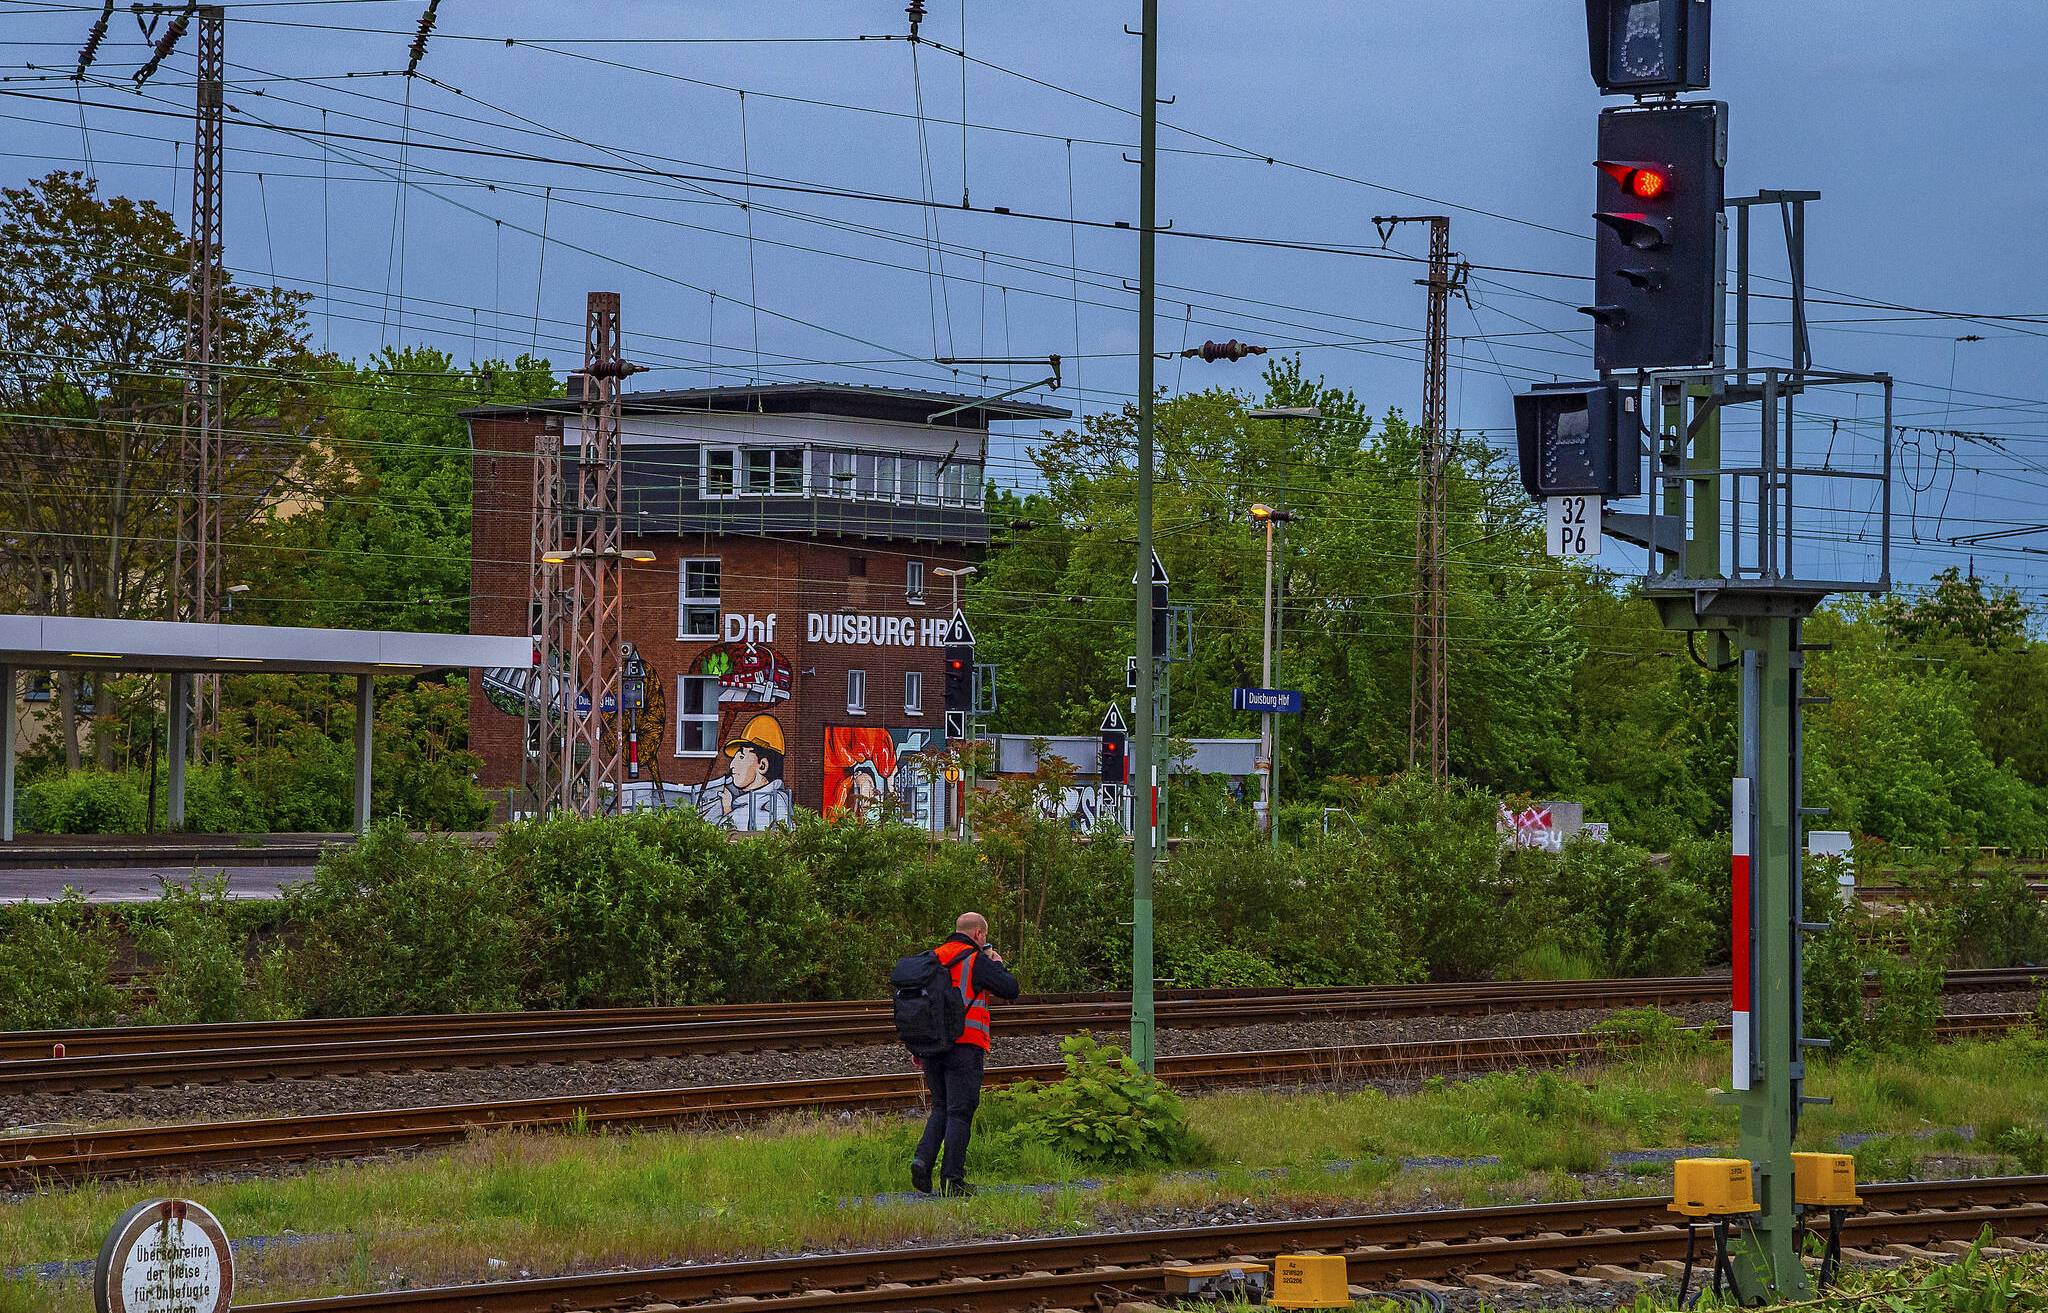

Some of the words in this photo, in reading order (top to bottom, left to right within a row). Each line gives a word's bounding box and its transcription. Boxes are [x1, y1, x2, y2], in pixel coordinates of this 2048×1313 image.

[1562, 497, 1586, 524] 32
[1562, 527, 1586, 553] P6
[724, 613, 777, 643] Dhf
[807, 613, 915, 646] DUISBURG
[920, 618, 953, 647] HB
[954, 620, 963, 640] 6
[1248, 692, 1277, 708] Duisburg
[1278, 693, 1290, 706] Hbf
[1110, 711, 1117, 727] 9
[137, 1243, 210, 1262] Überschreiten
[146, 1266, 164, 1281] der
[168, 1264, 200, 1279] Gleise
[134, 1286, 151, 1303] für
[156, 1282, 210, 1300] Unbefugte
